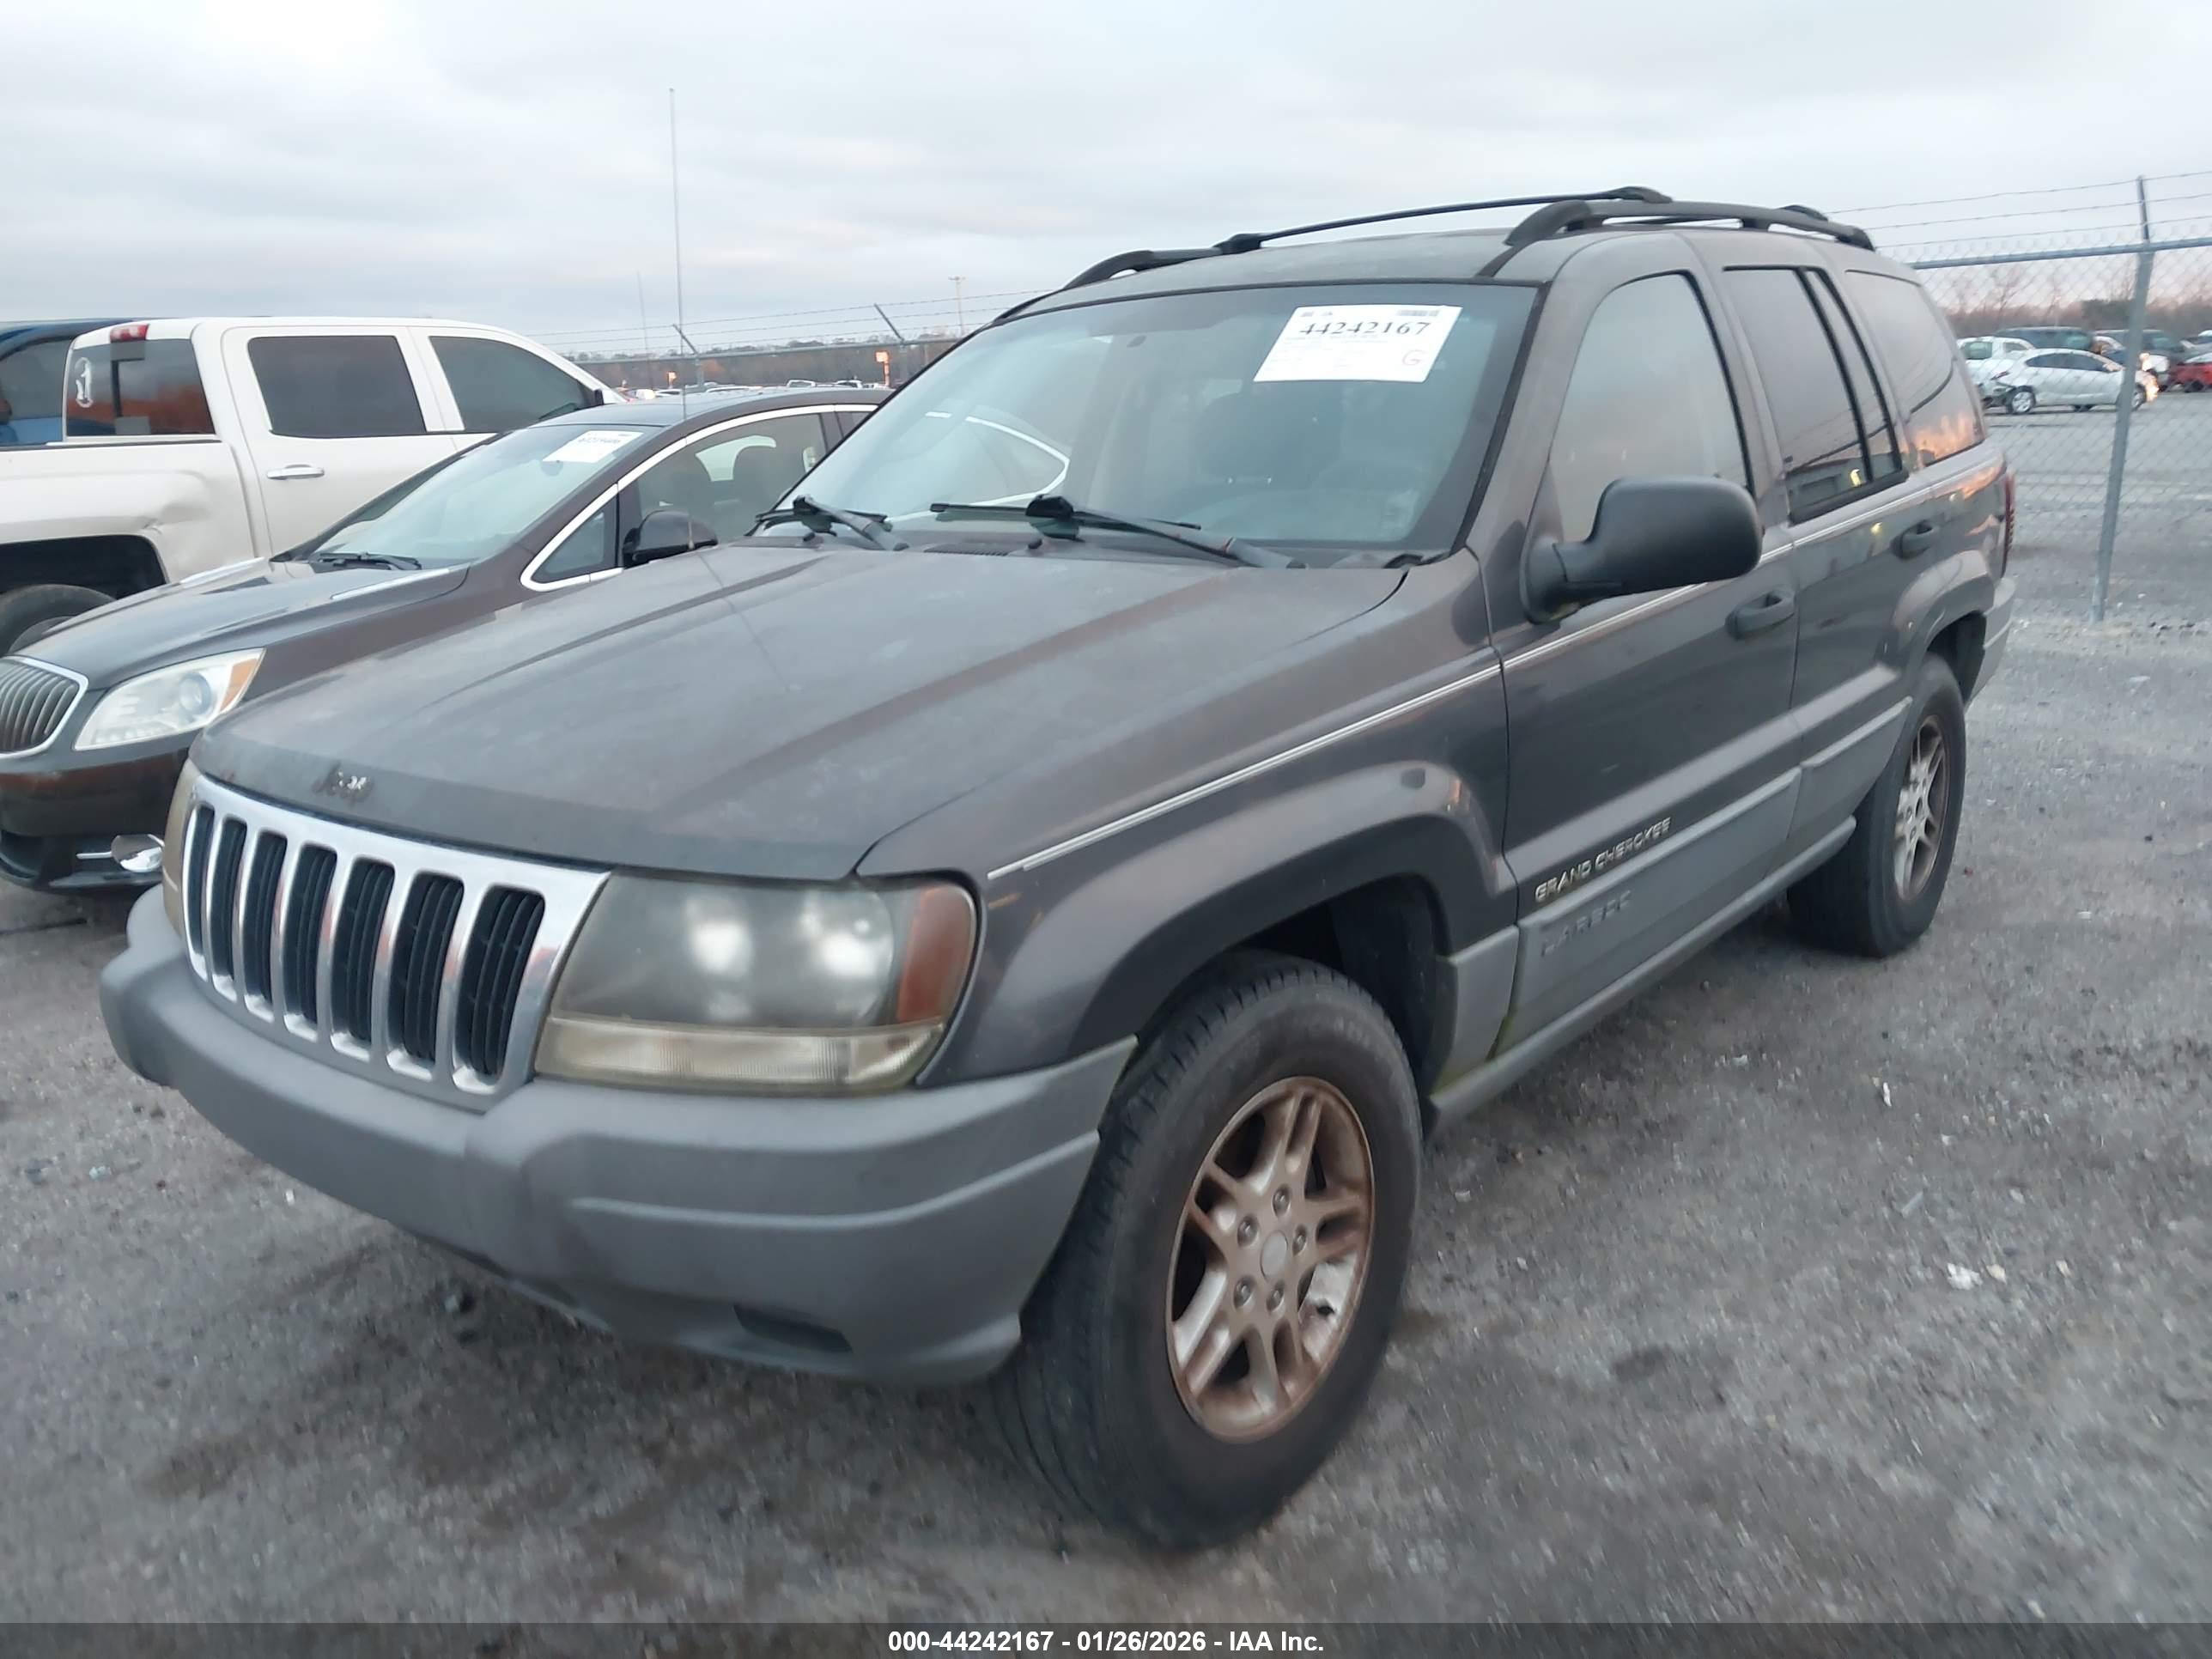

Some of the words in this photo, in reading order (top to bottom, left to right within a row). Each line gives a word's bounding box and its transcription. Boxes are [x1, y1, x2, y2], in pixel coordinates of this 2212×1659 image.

[1299, 321, 1432, 336] 44242167
[1534, 860, 1592, 902] GRAND
[1595, 817, 1672, 872] CHEROKEE
